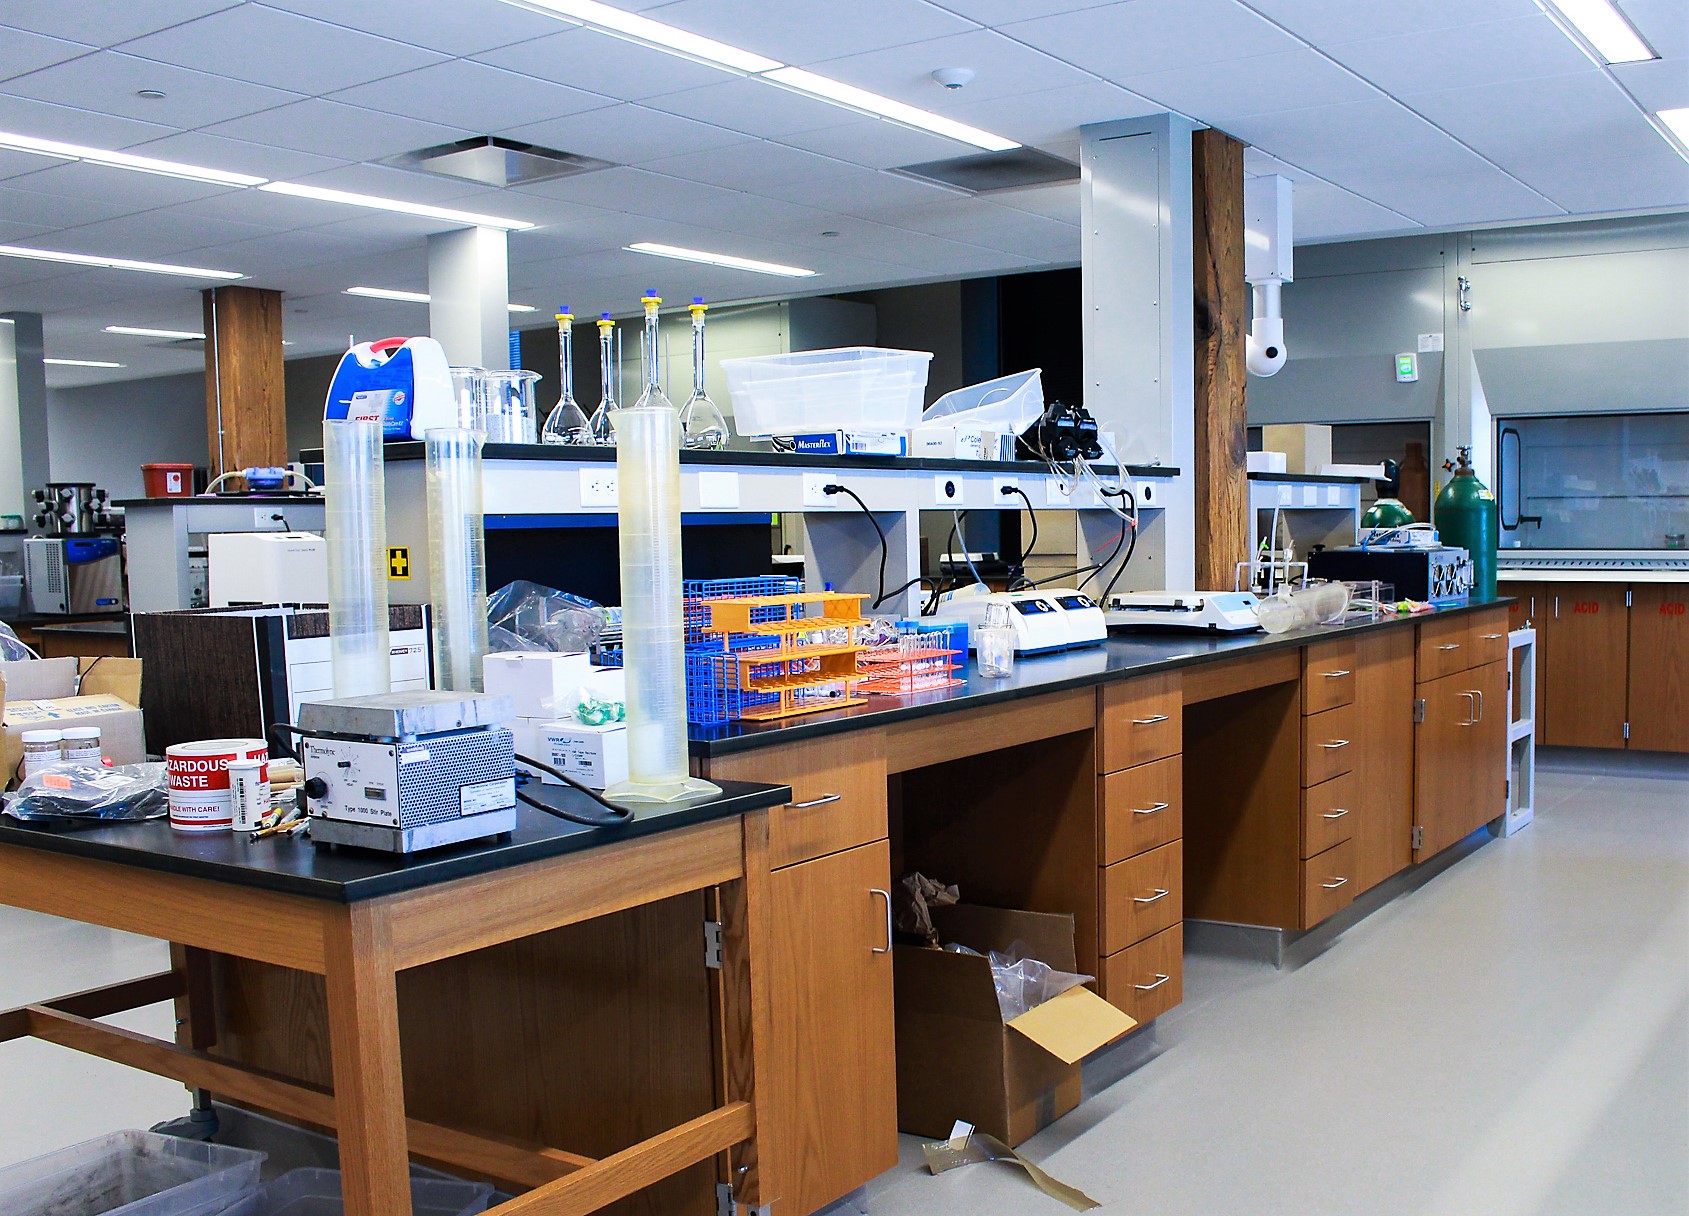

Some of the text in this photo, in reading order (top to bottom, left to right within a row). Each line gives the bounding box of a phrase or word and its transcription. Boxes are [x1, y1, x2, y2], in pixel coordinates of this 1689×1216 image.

[1574, 601, 1599, 614] ACID
[1659, 602, 1685, 615] ACID
[168, 759, 229, 773] ZARDOUS
[170, 775, 209, 788] WASTE
[198, 805, 220, 813] CARE!
[344, 804, 356, 813] Type
[357, 806, 369, 814] 1000
[380, 809, 392, 817] Plate
